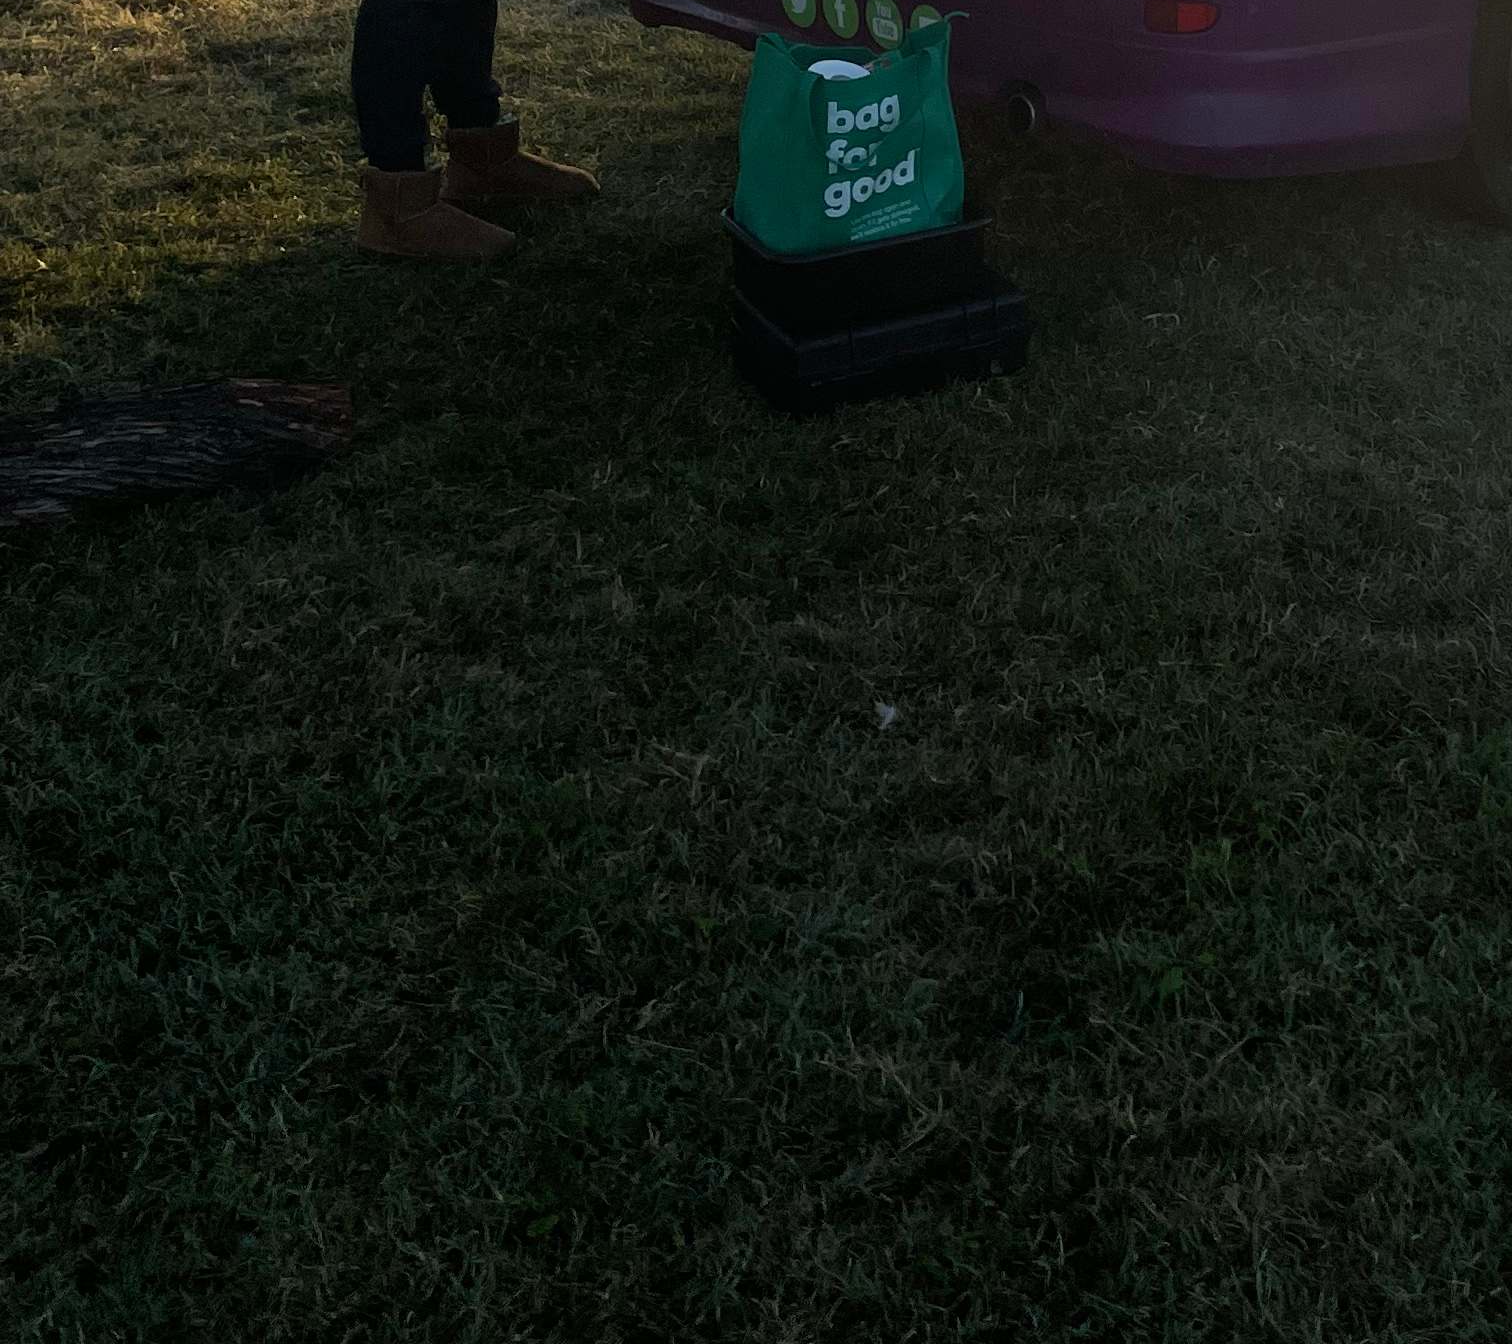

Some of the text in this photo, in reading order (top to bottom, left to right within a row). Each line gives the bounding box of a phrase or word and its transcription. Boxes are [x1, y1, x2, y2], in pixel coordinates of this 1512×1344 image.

[827, 94, 900, 134] bag
[826, 139, 883, 175] for
[824, 148, 919, 218] good
